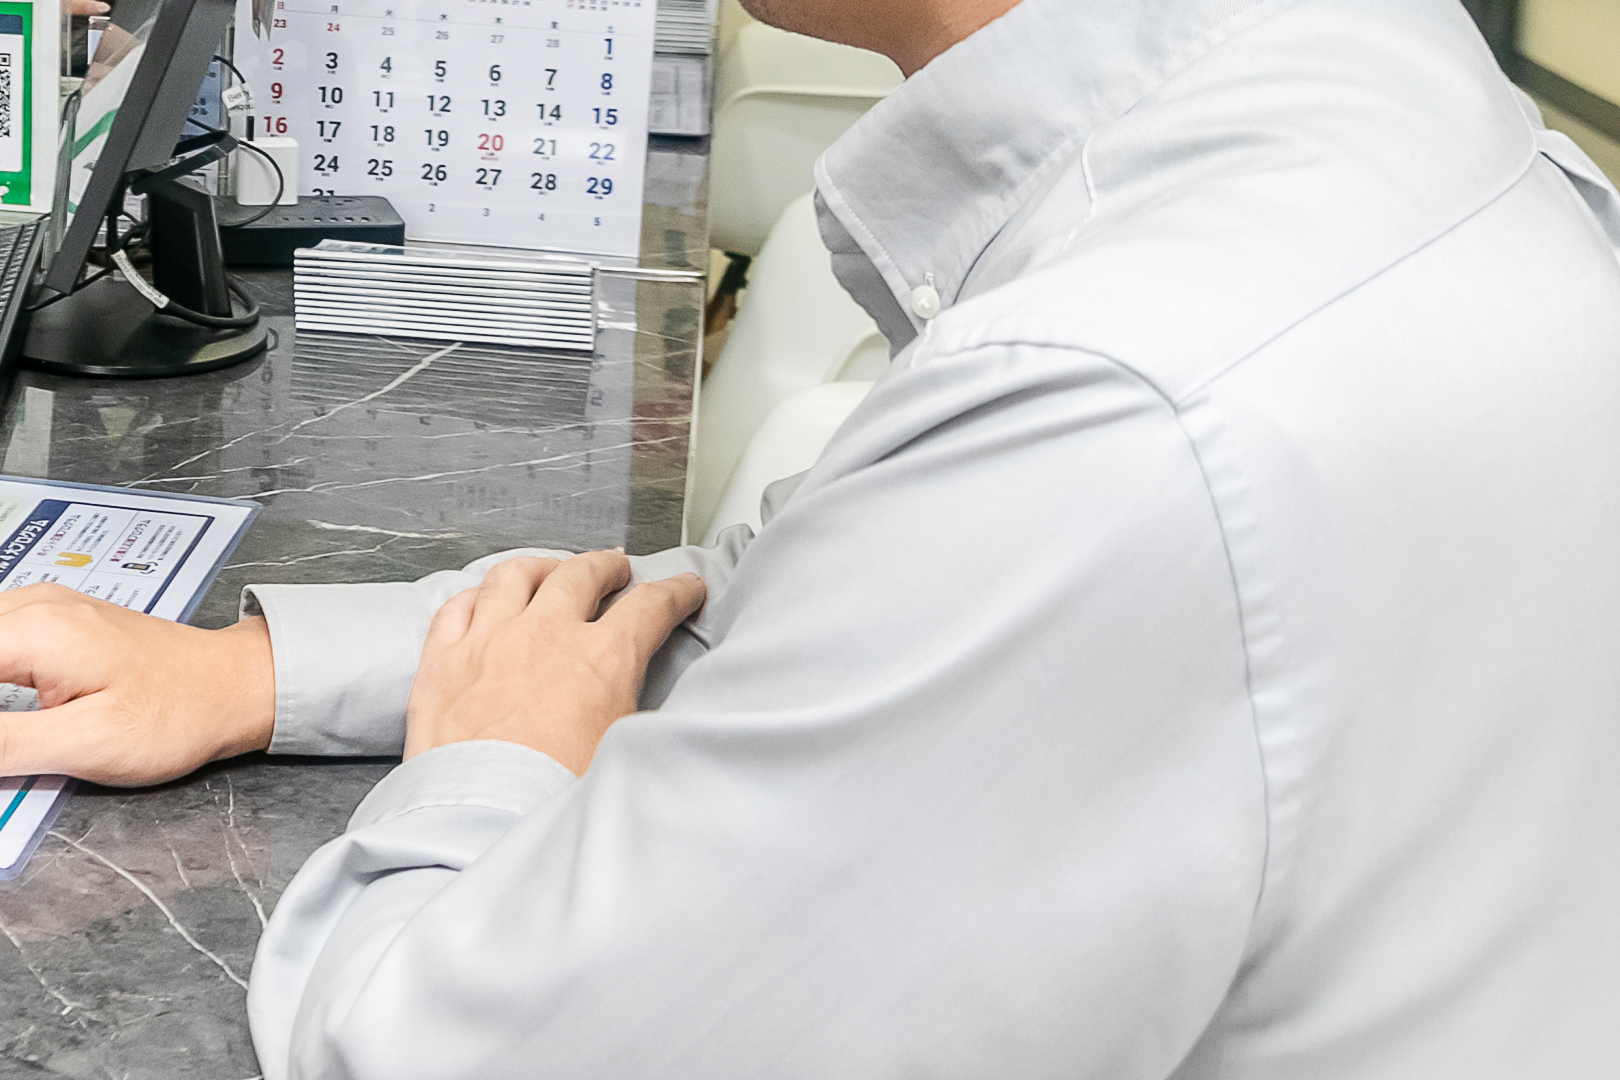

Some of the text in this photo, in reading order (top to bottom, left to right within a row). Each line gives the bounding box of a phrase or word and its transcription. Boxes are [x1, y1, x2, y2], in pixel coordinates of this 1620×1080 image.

[273, 19, 287, 29] 23
[326, 23, 340, 32] 24
[381, 27, 395, 36] 25
[435, 31, 449, 40] 26
[490, 34, 505, 44] 27
[603, 38, 613, 55] 1
[272, 48, 613, 90] 2 3 4 5 6 7 8
[270, 82, 618, 125] 9 10 11 12 13 14 15
[263, 116, 615, 161] 16 17 18 19 20 21 22
[314, 154, 613, 195] 24 25 26 27 28 29
[429, 204, 435, 213] 2
[482, 208, 490, 217] 3
[594, 217, 601, 226] 5
